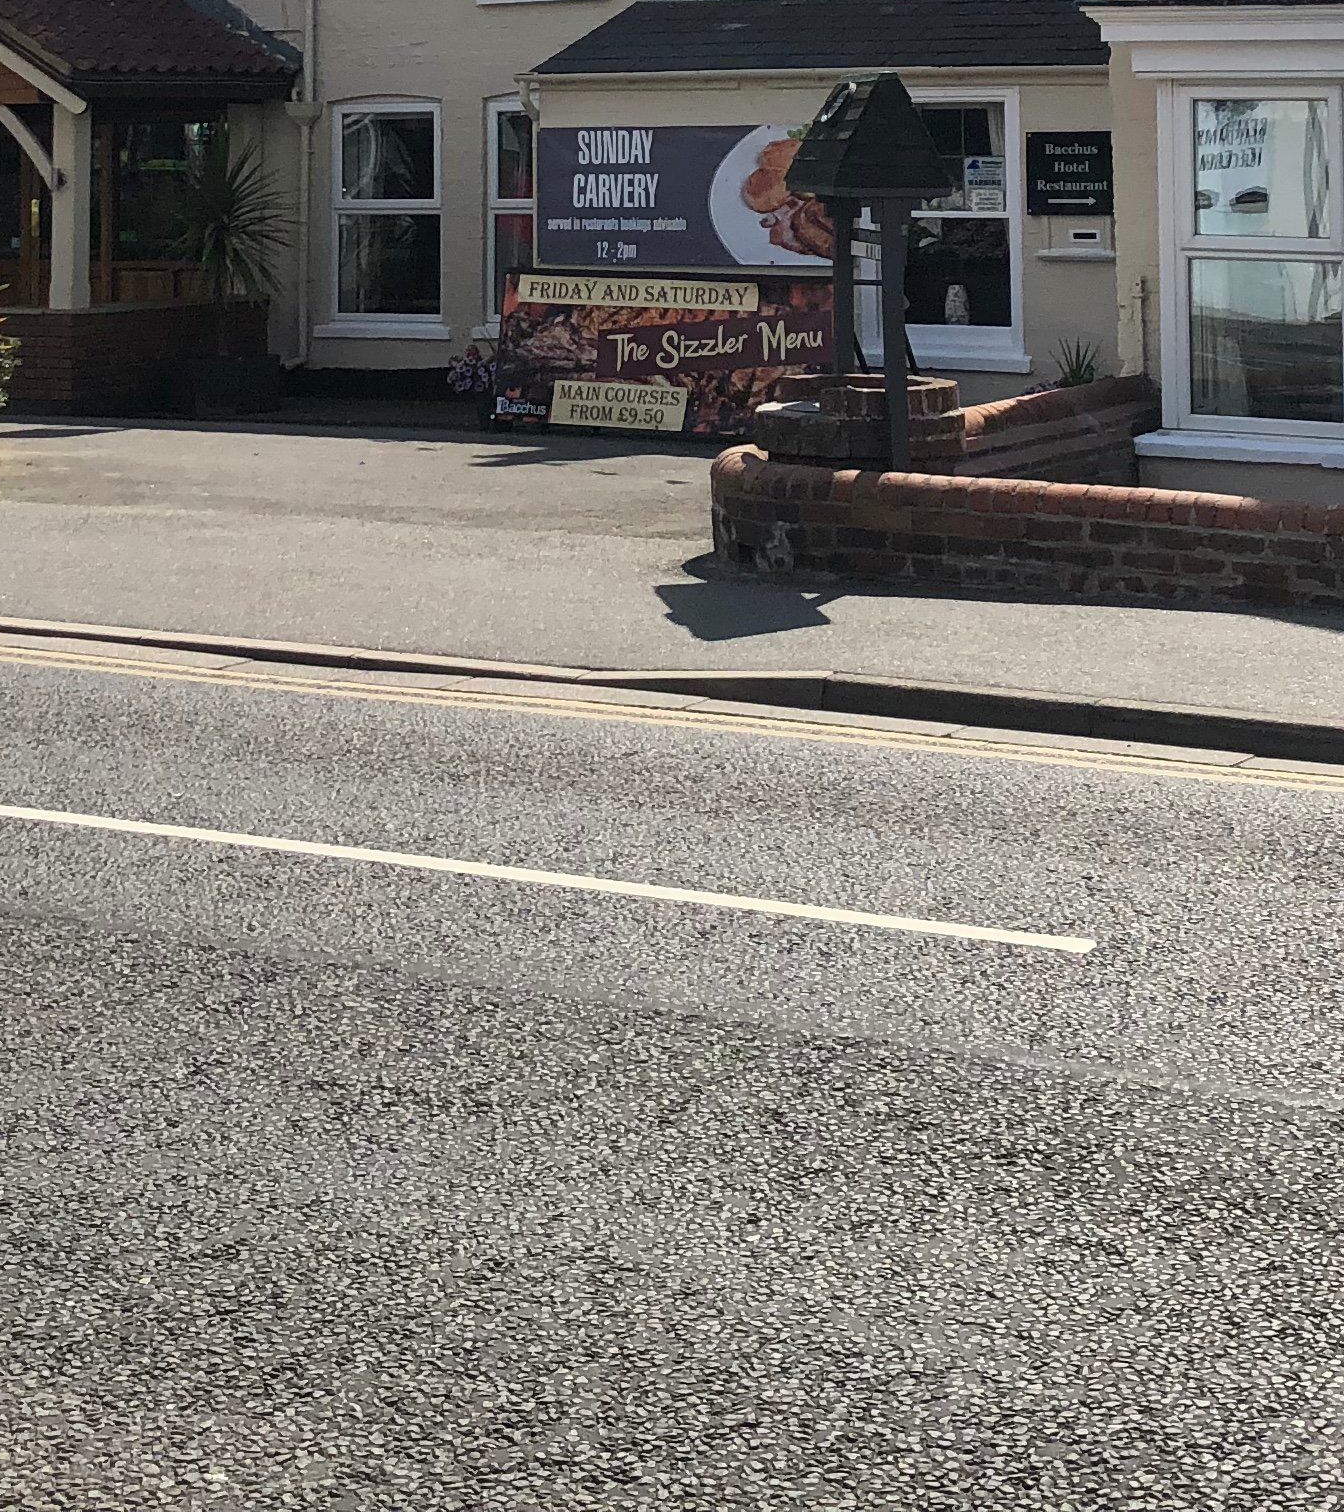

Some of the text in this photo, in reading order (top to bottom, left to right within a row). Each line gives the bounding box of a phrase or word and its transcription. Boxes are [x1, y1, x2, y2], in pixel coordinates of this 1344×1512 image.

[577, 129, 654, 165] SUNDAY
[1044, 142, 1099, 156] Bacchus
[1054, 160, 1090, 173] Hotel
[572, 173, 659, 208] CARVERY
[1036, 179, 1108, 192] Restaurant
[596, 241, 609, 258] 12
[528, 280, 750, 307] FRIDAY AND SATURDAY
[606, 319, 825, 372] The Sizzler Menu
[496, 397, 547, 415] Bacchus
[558, 385, 681, 406] MAIN COURSES
[569, 403, 665, 425] FROM £9.50
